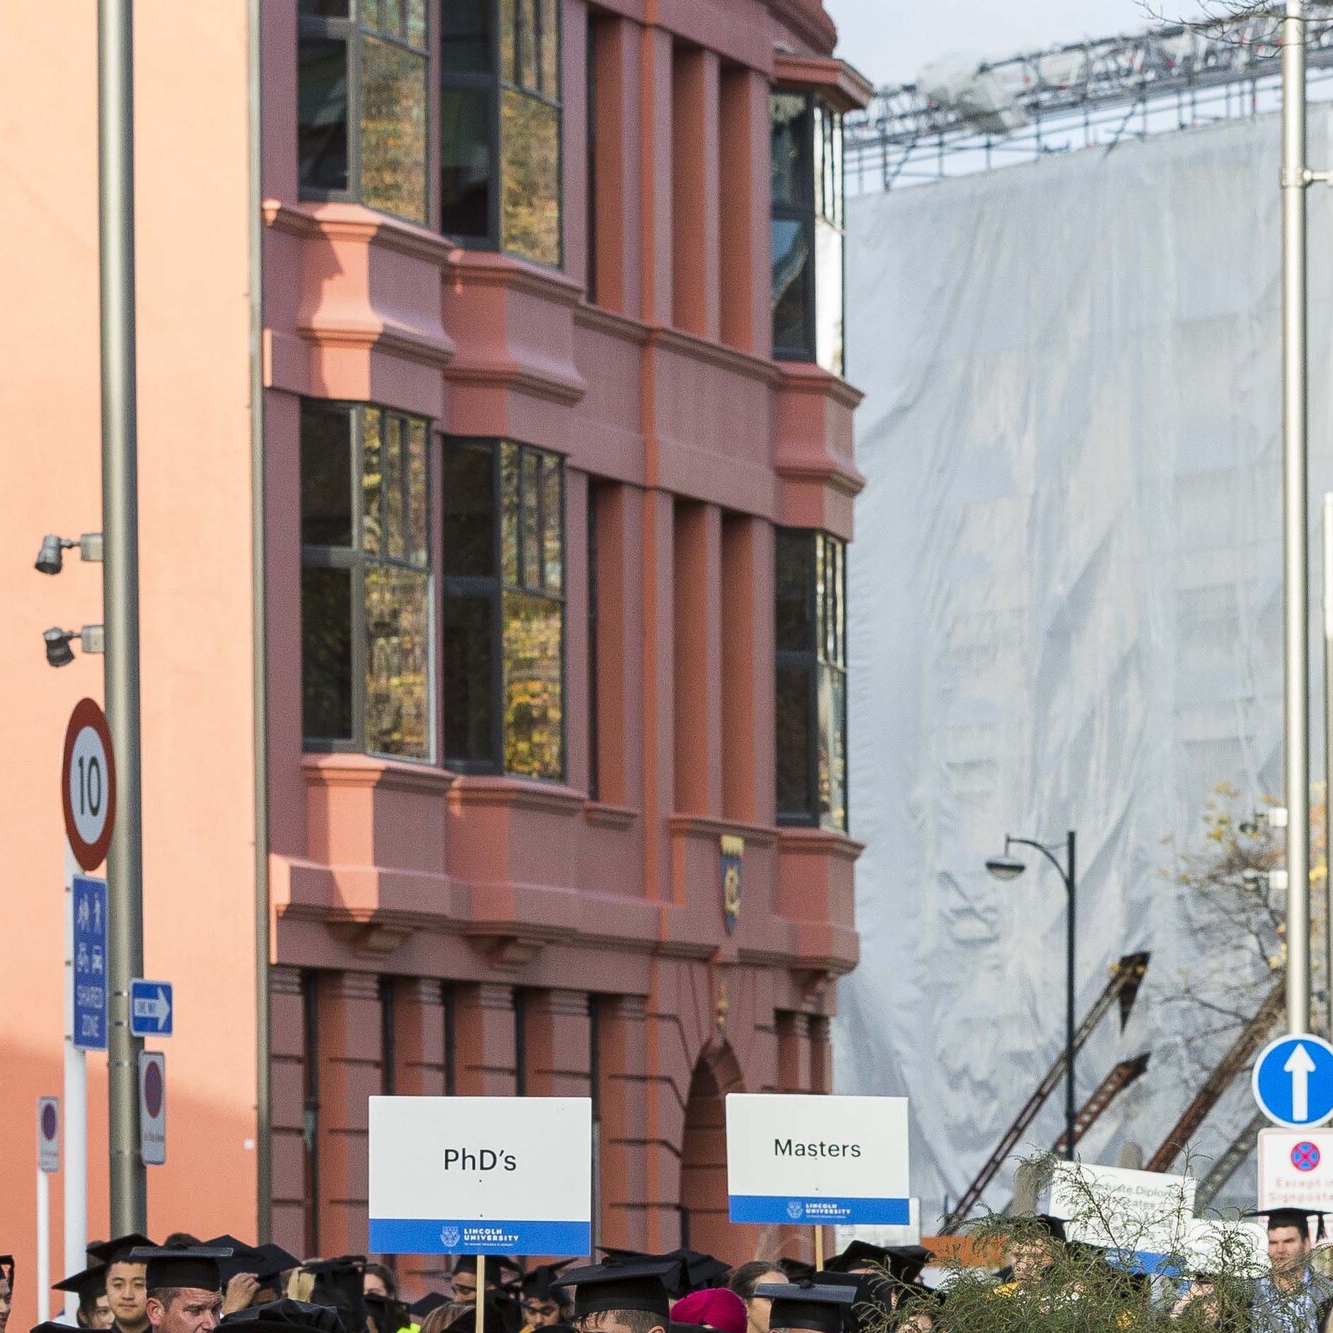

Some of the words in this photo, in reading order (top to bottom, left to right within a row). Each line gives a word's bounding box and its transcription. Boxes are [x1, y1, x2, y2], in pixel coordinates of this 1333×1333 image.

[78, 755, 101, 817] 10
[444, 1147, 517, 1171] PhD's
[774, 1138, 861, 1158] Masters
[463, 1234, 519, 1242] UNIVERSITY
